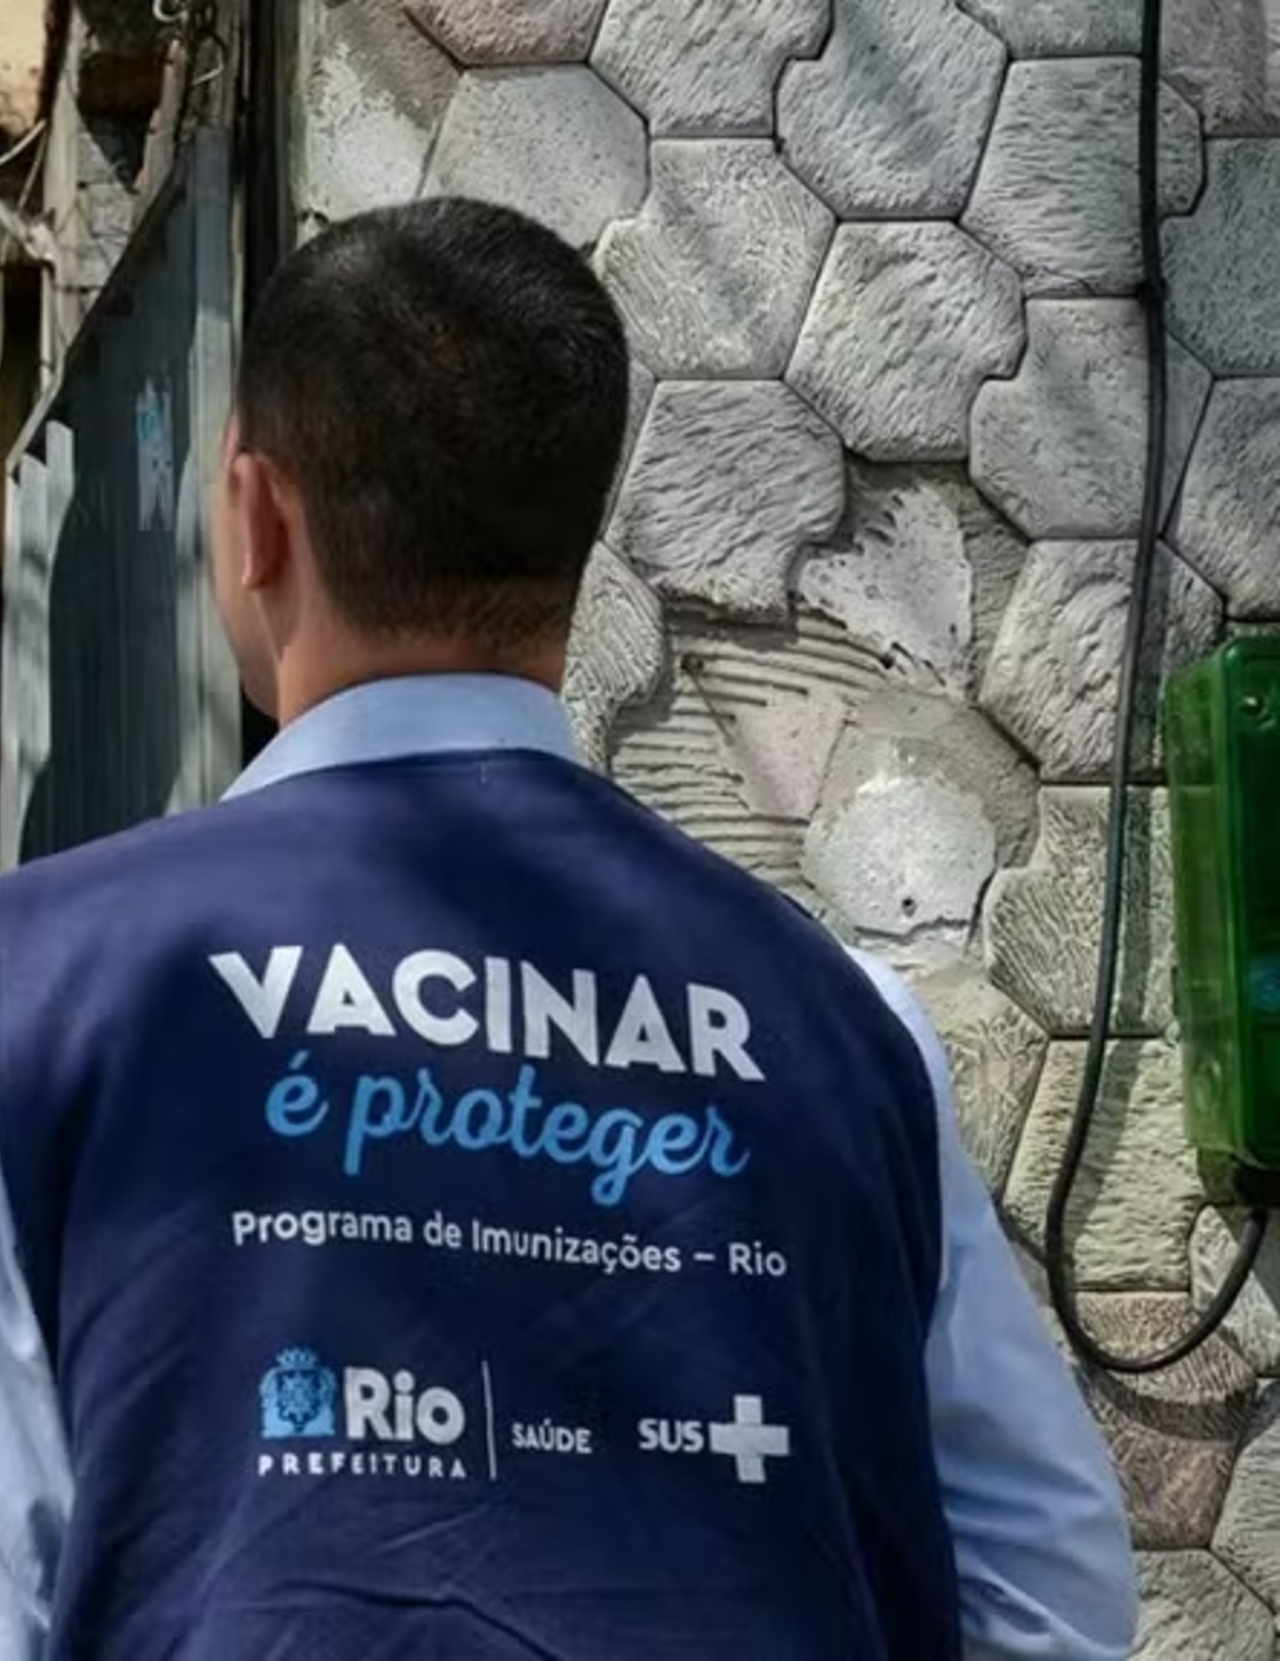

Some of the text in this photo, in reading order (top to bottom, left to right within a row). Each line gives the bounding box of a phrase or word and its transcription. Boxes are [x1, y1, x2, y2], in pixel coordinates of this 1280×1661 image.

[208, 943, 765, 1080] VACINAR
[265, 1050, 750, 1206] é proteger
[232, 1210, 413, 1248] Programa
[423, 1211, 462, 1251] de
[471, 1219, 682, 1275] Imunizações
[728, 1241, 788, 1277] Rio
[343, 1365, 466, 1445] Rio
[511, 1417, 593, 1455] SAÚDE
[638, 1417, 705, 1454] SUS
[257, 1454, 467, 1480] PREFEITURA
